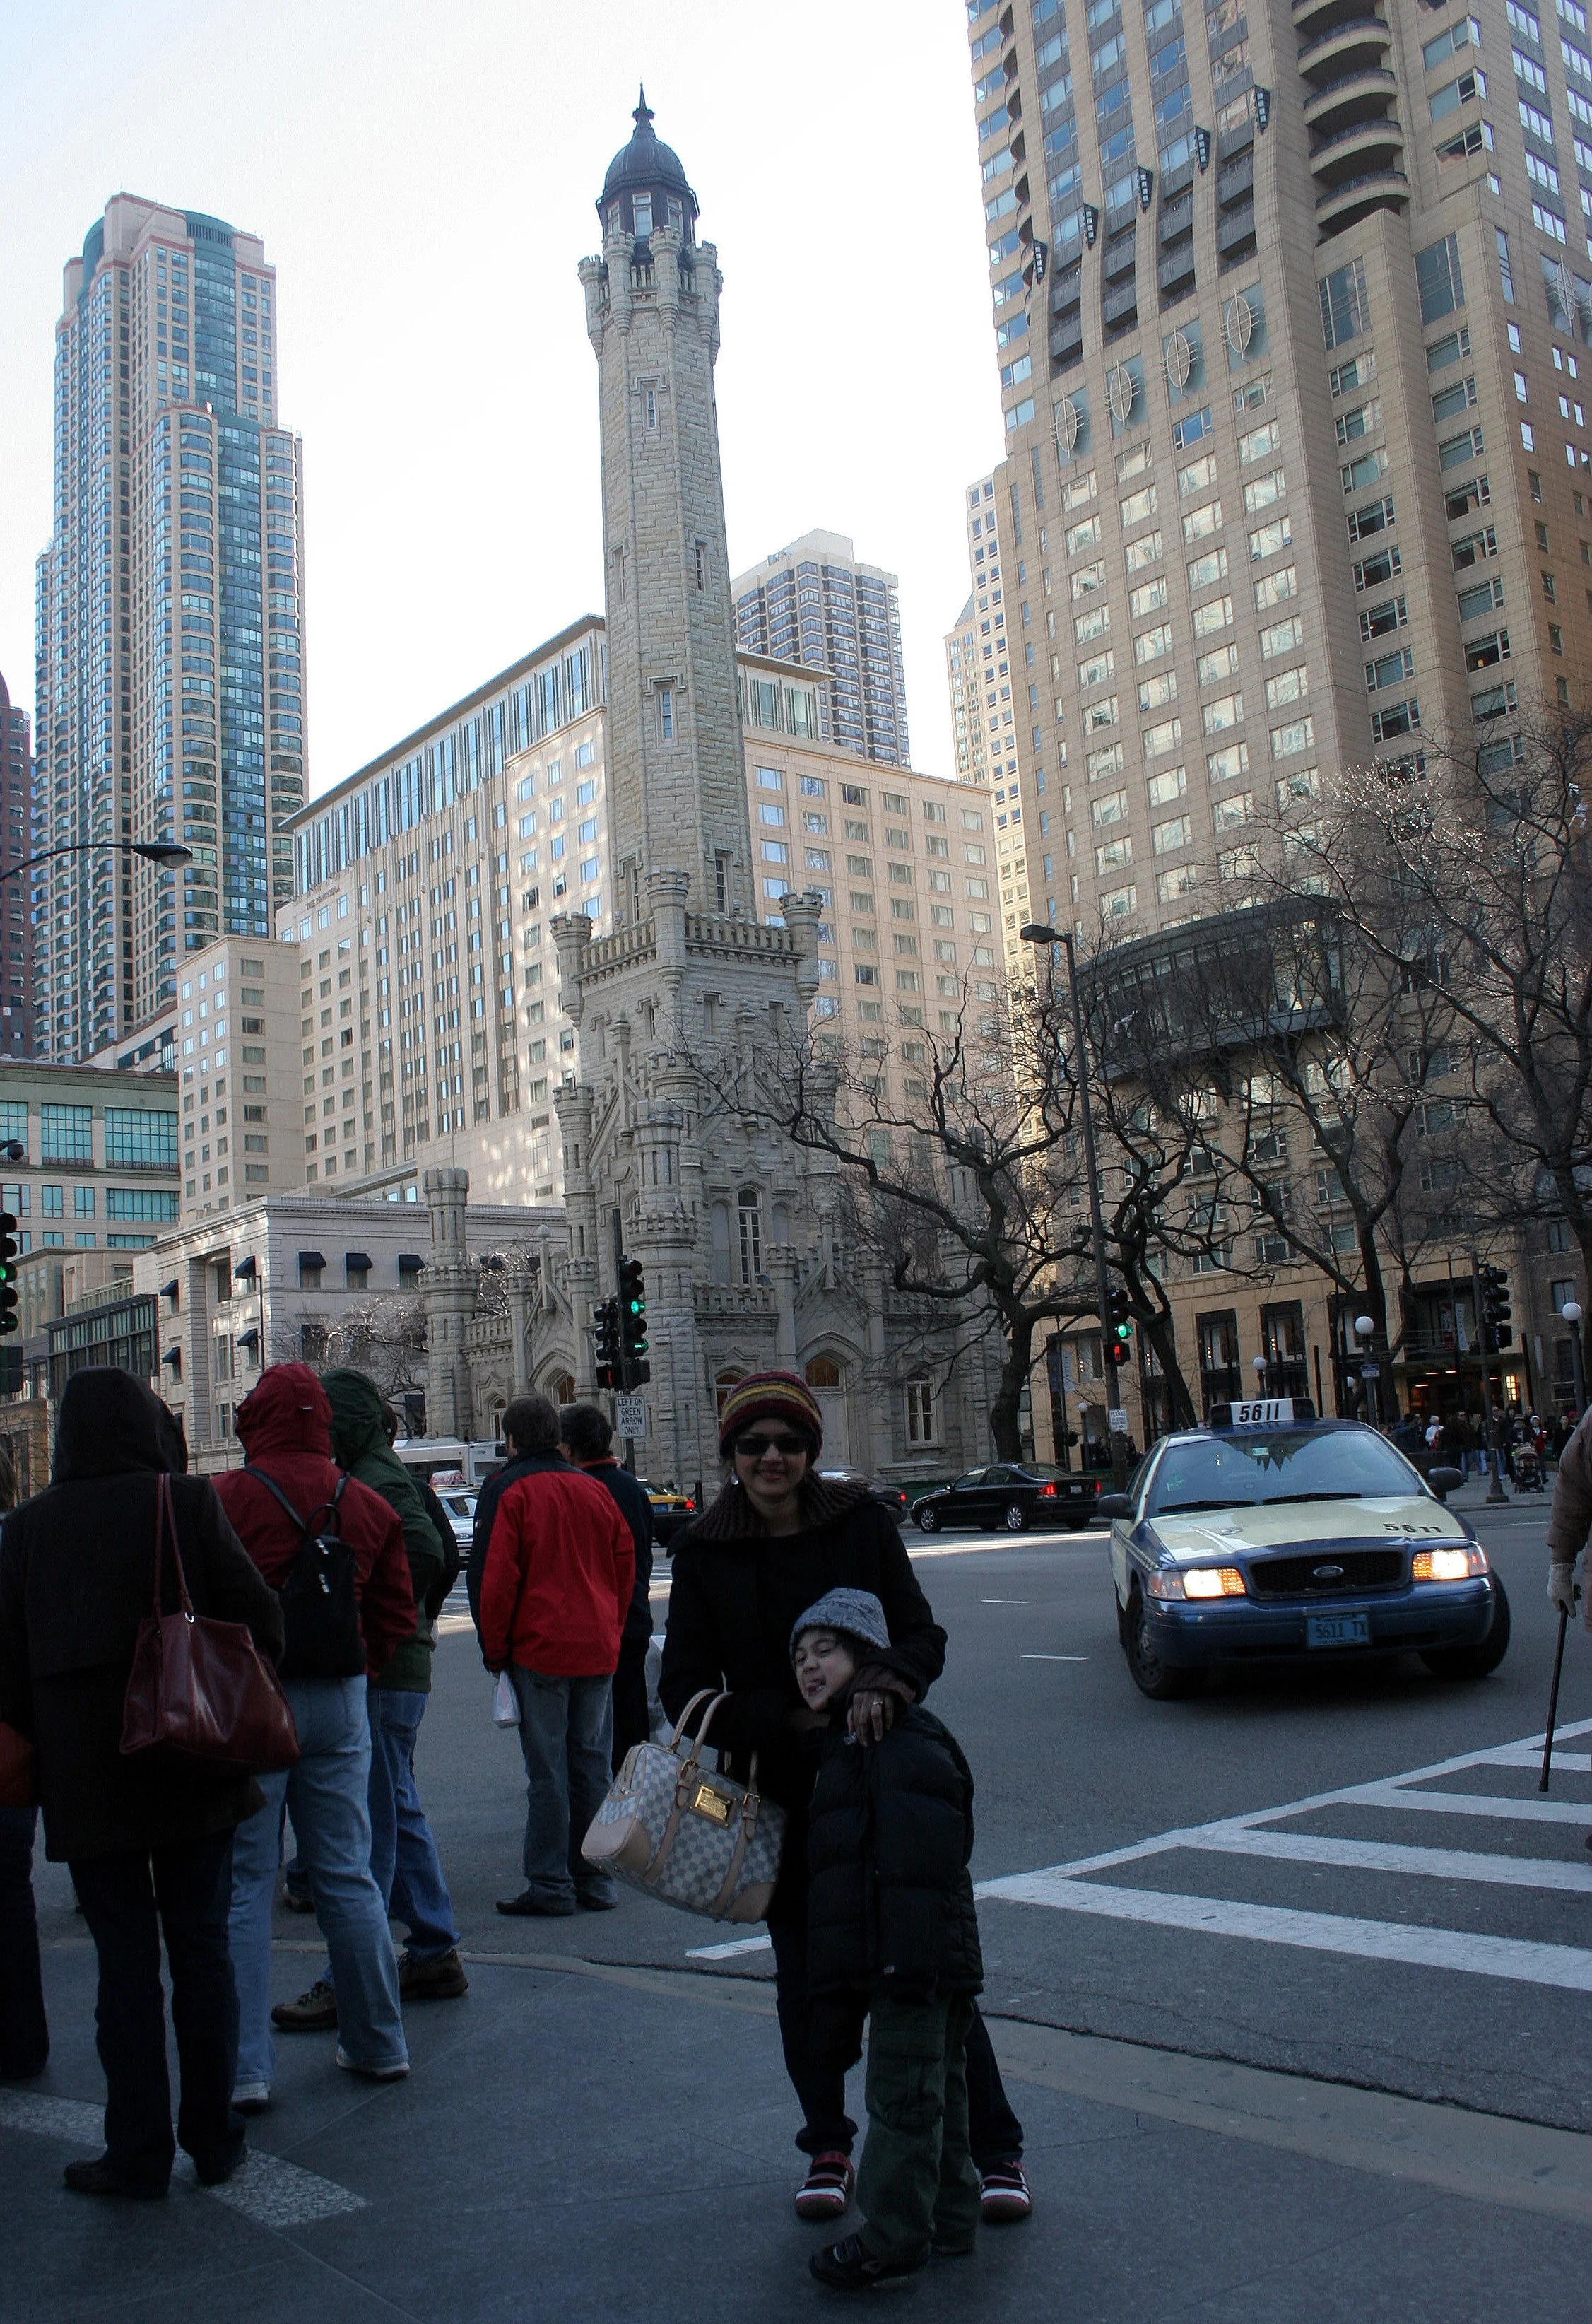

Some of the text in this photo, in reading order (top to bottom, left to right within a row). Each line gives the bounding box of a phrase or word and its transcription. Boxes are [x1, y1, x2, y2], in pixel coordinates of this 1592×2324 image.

[621, 1407, 641, 1416] GREEN
[1239, 1402, 1279, 1422] 5611
[624, 1426, 639, 1435] ONLY
[1383, 1523, 1443, 1533] 5611
[1316, 1621, 1368, 1638] 5611 TX
